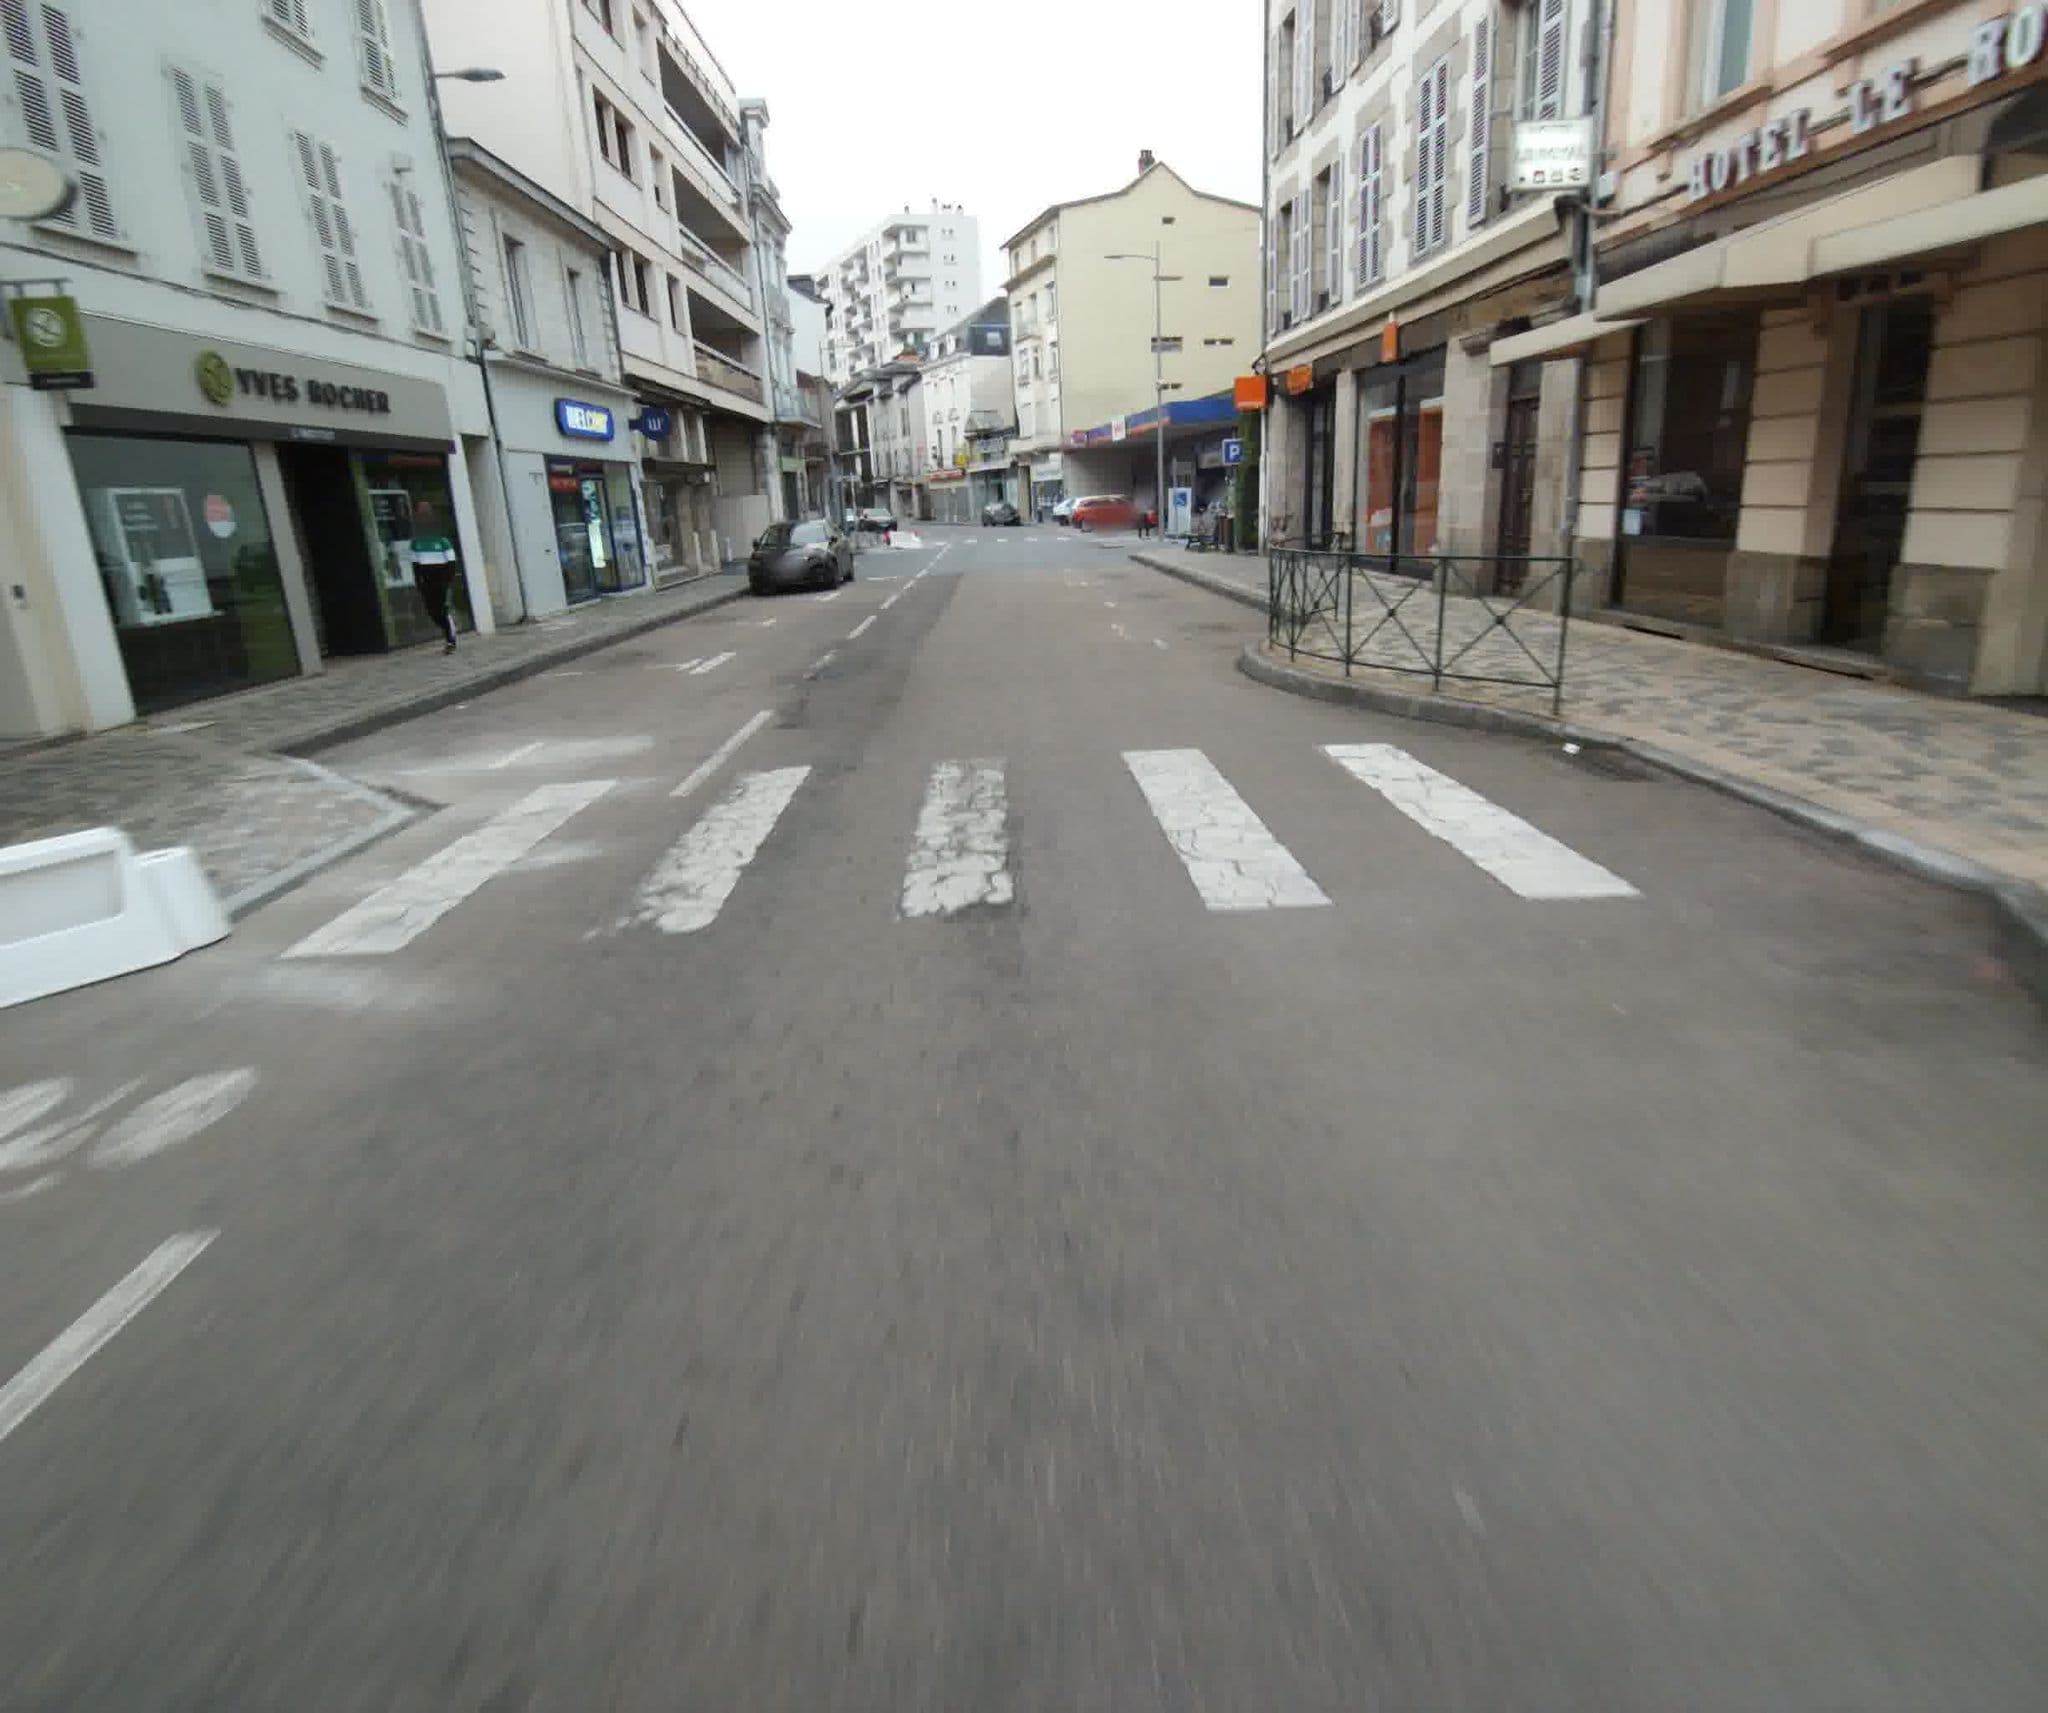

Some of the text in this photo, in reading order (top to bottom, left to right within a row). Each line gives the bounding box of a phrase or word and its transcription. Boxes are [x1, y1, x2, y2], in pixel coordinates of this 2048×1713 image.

[1687, 108, 1813, 201] HOTEL
[1848, 58, 1916, 133] LE
[235, 368, 391, 413] YVES ROCHER
